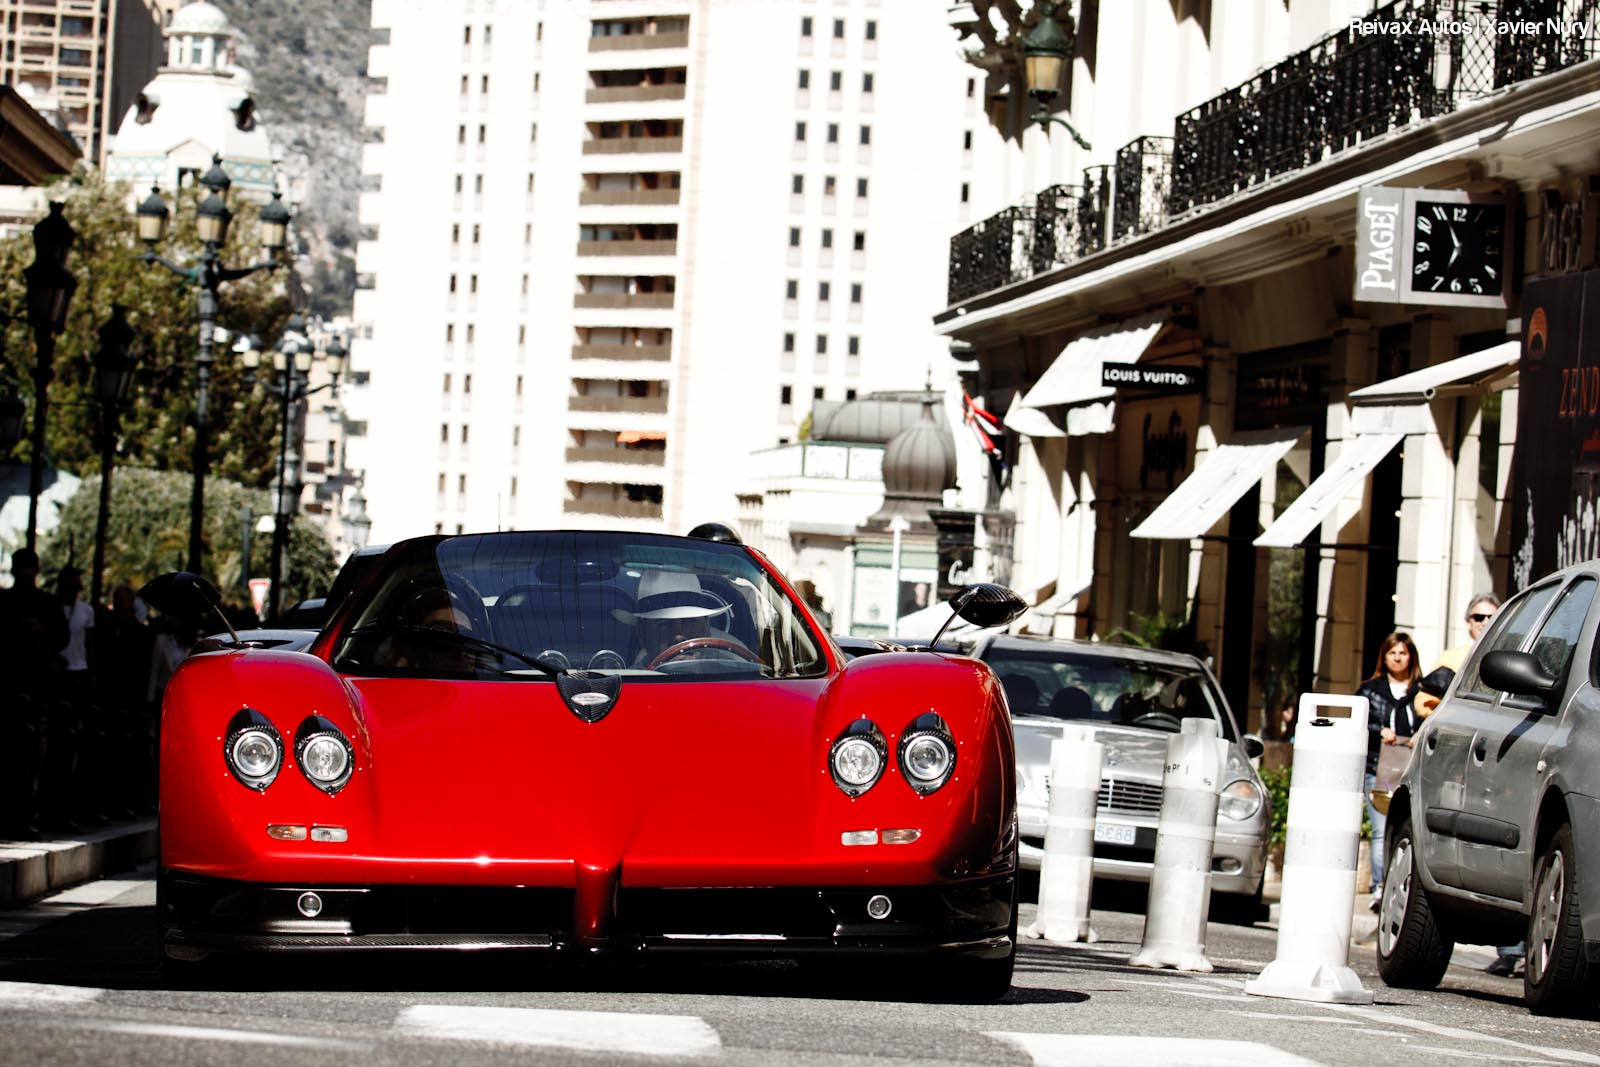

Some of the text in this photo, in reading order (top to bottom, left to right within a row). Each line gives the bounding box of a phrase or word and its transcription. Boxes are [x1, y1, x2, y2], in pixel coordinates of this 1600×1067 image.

[1452, 206, 1469, 223] 12
[1416, 215, 1433, 236] 10
[1360, 196, 1400, 291] PIAGET
[1415, 241, 1431, 253] 9
[1413, 260, 1431, 275] 8
[1430, 275, 1446, 291] 7
[1449, 277, 1463, 293] 6
[1468, 277, 1484, 294] 5
[1104, 368, 1141, 383] LOUIS
